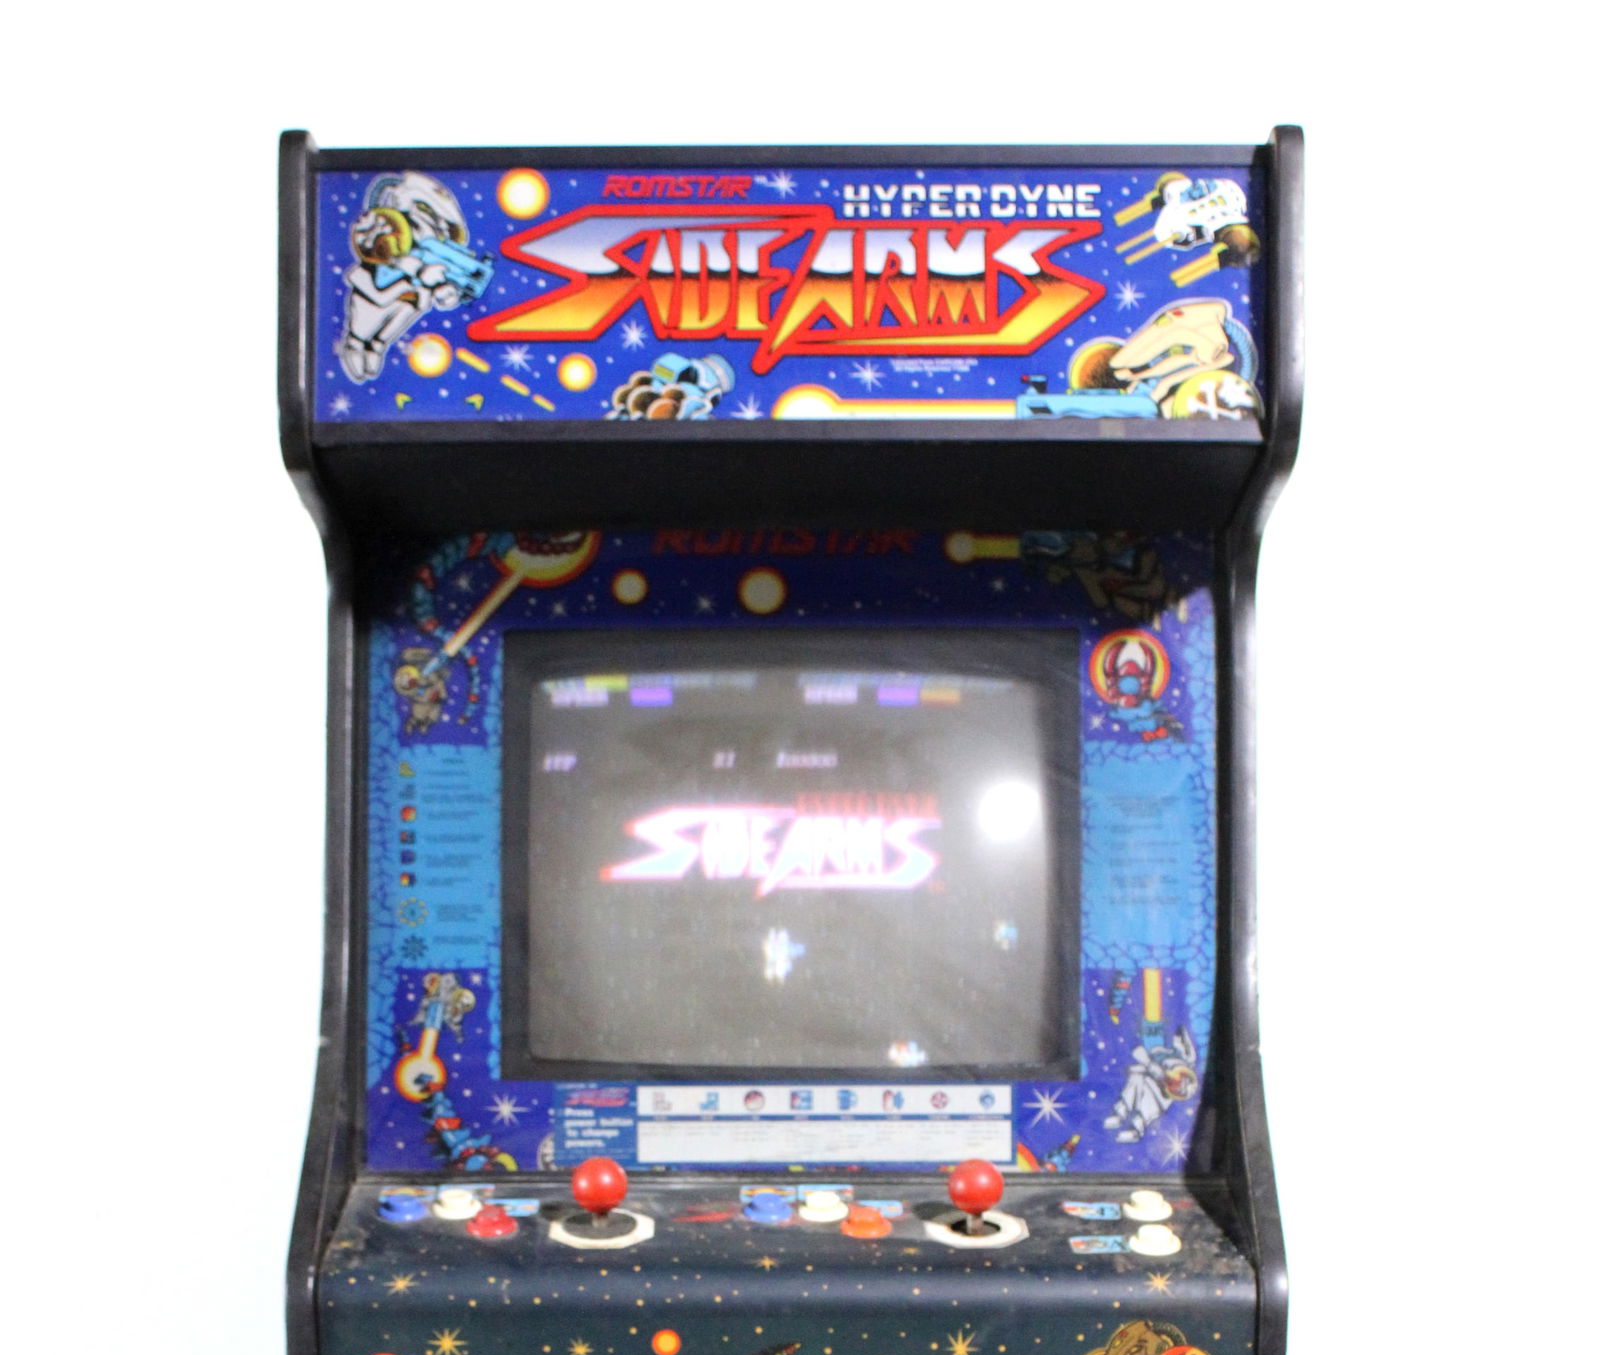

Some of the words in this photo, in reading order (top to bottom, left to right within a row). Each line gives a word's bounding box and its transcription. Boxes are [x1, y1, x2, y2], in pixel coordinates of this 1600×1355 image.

[603, 174, 753, 199] ROMSTAR
[842, 183, 982, 218] HYPER
[989, 183, 1101, 218] DYNE
[467, 205, 802, 341] SIDE
[752, 220, 1107, 374] ARMS
